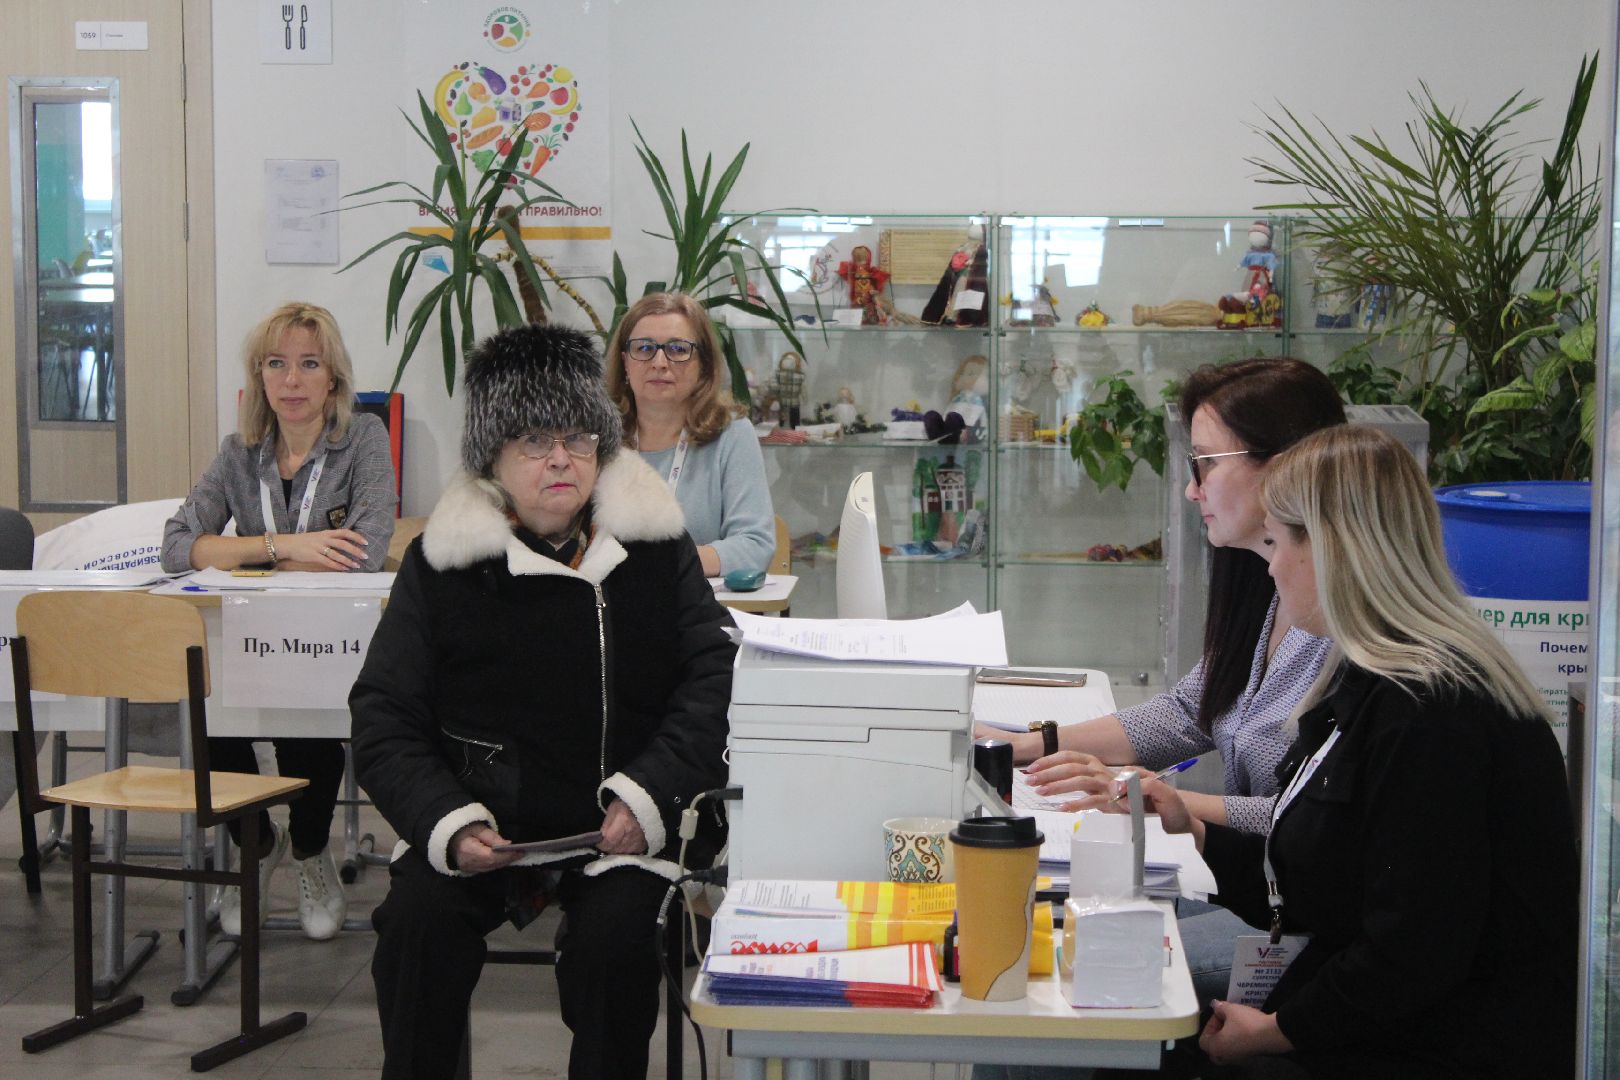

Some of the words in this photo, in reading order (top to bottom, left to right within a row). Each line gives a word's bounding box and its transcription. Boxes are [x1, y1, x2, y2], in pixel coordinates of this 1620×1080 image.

[1510, 611, 1550, 628] для
[244, 637, 275, 658] Пр.
[282, 638, 334, 658] Мира
[342, 639, 361, 654] 14
